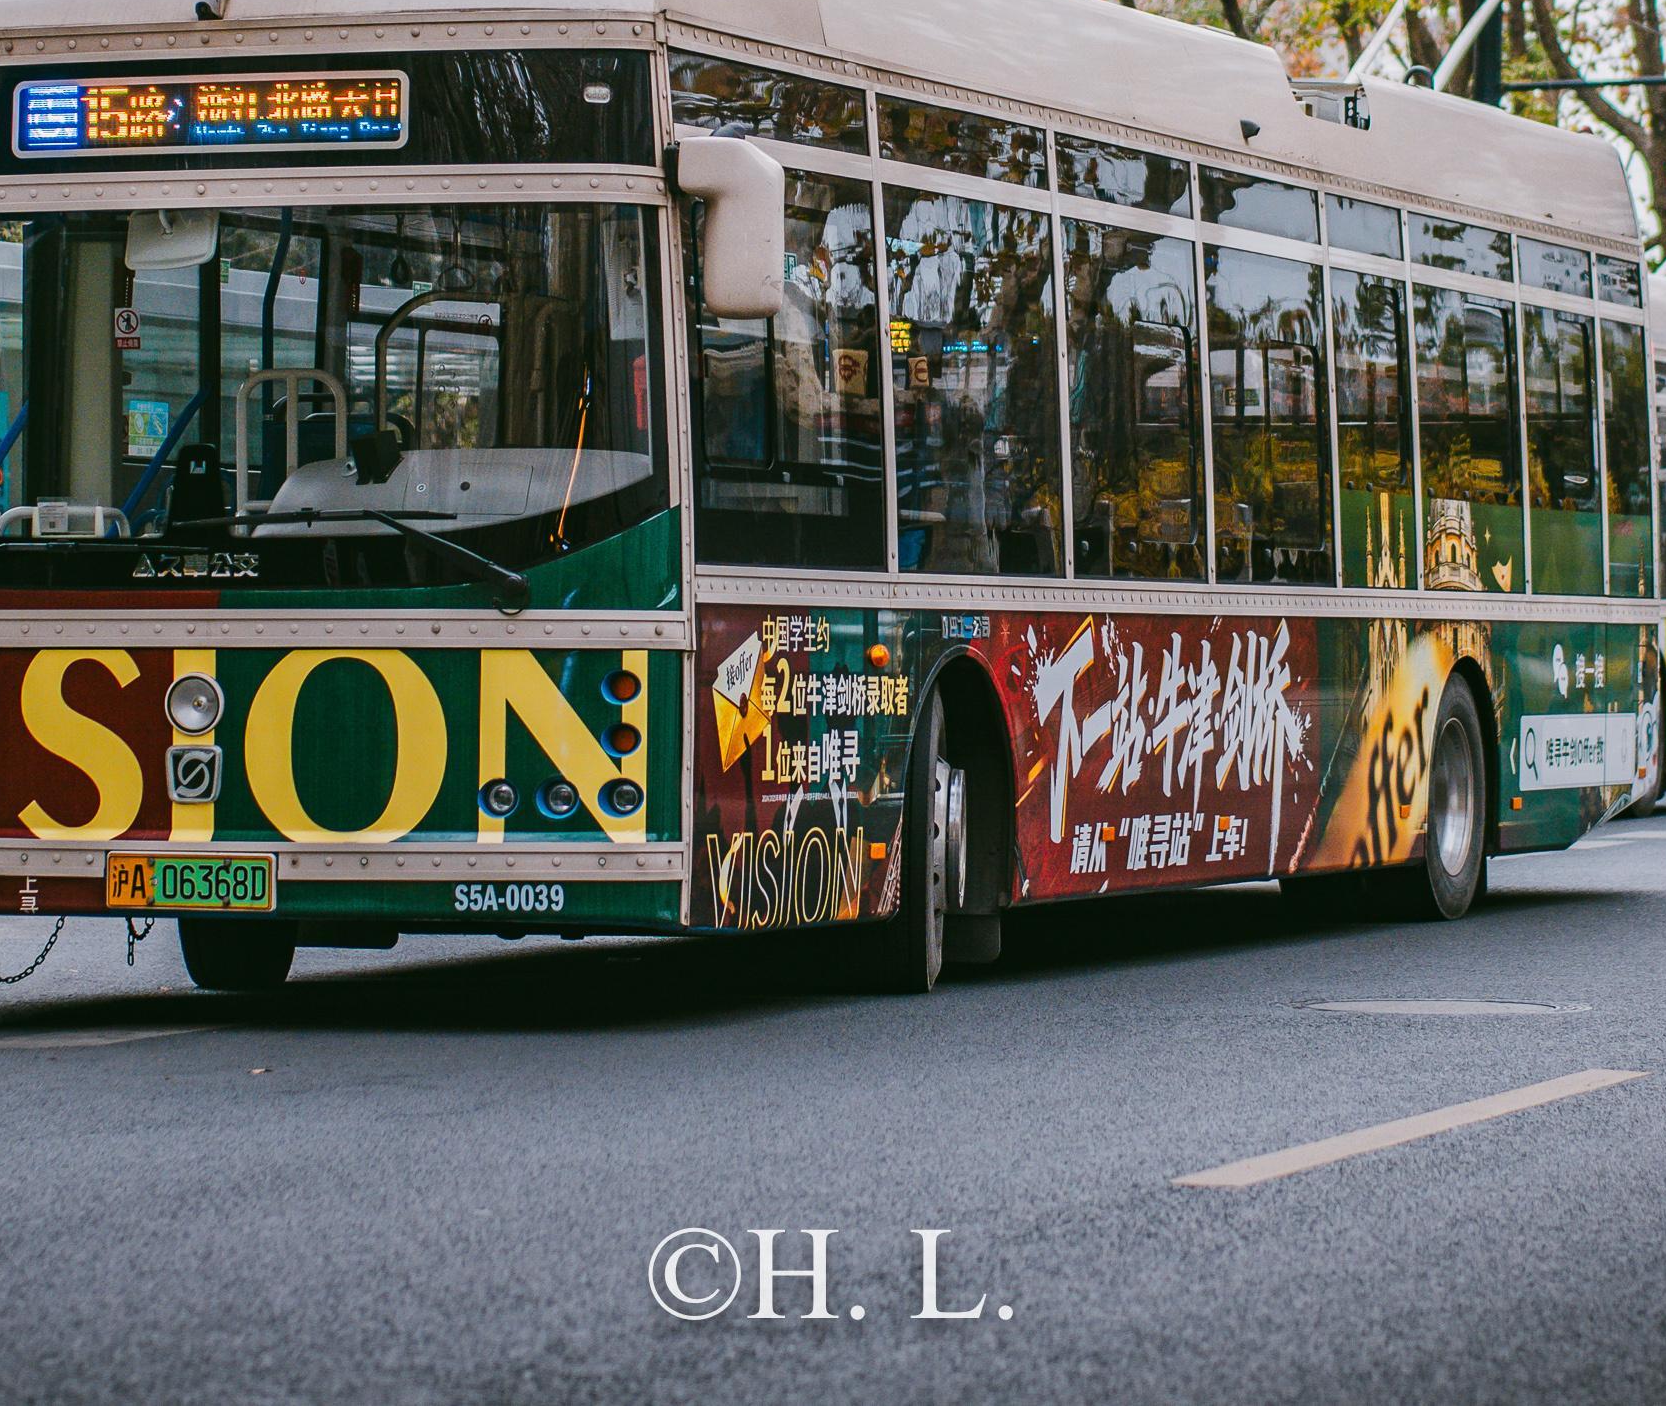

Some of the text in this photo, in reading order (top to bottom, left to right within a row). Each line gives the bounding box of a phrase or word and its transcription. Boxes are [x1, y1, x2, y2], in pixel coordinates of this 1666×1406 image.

[761, 615, 830, 654] 中国学生约
[761, 658, 909, 717] 每2位牛津剑桥录取者
[1575, 652, 1605, 689] 搜一搜
[761, 729, 861, 784] 1位来自唯寻
[112, 863, 267, 902] 沪A 06368D
[454, 883, 565, 912] S5A-0039
[707, 826, 864, 930] VISION
